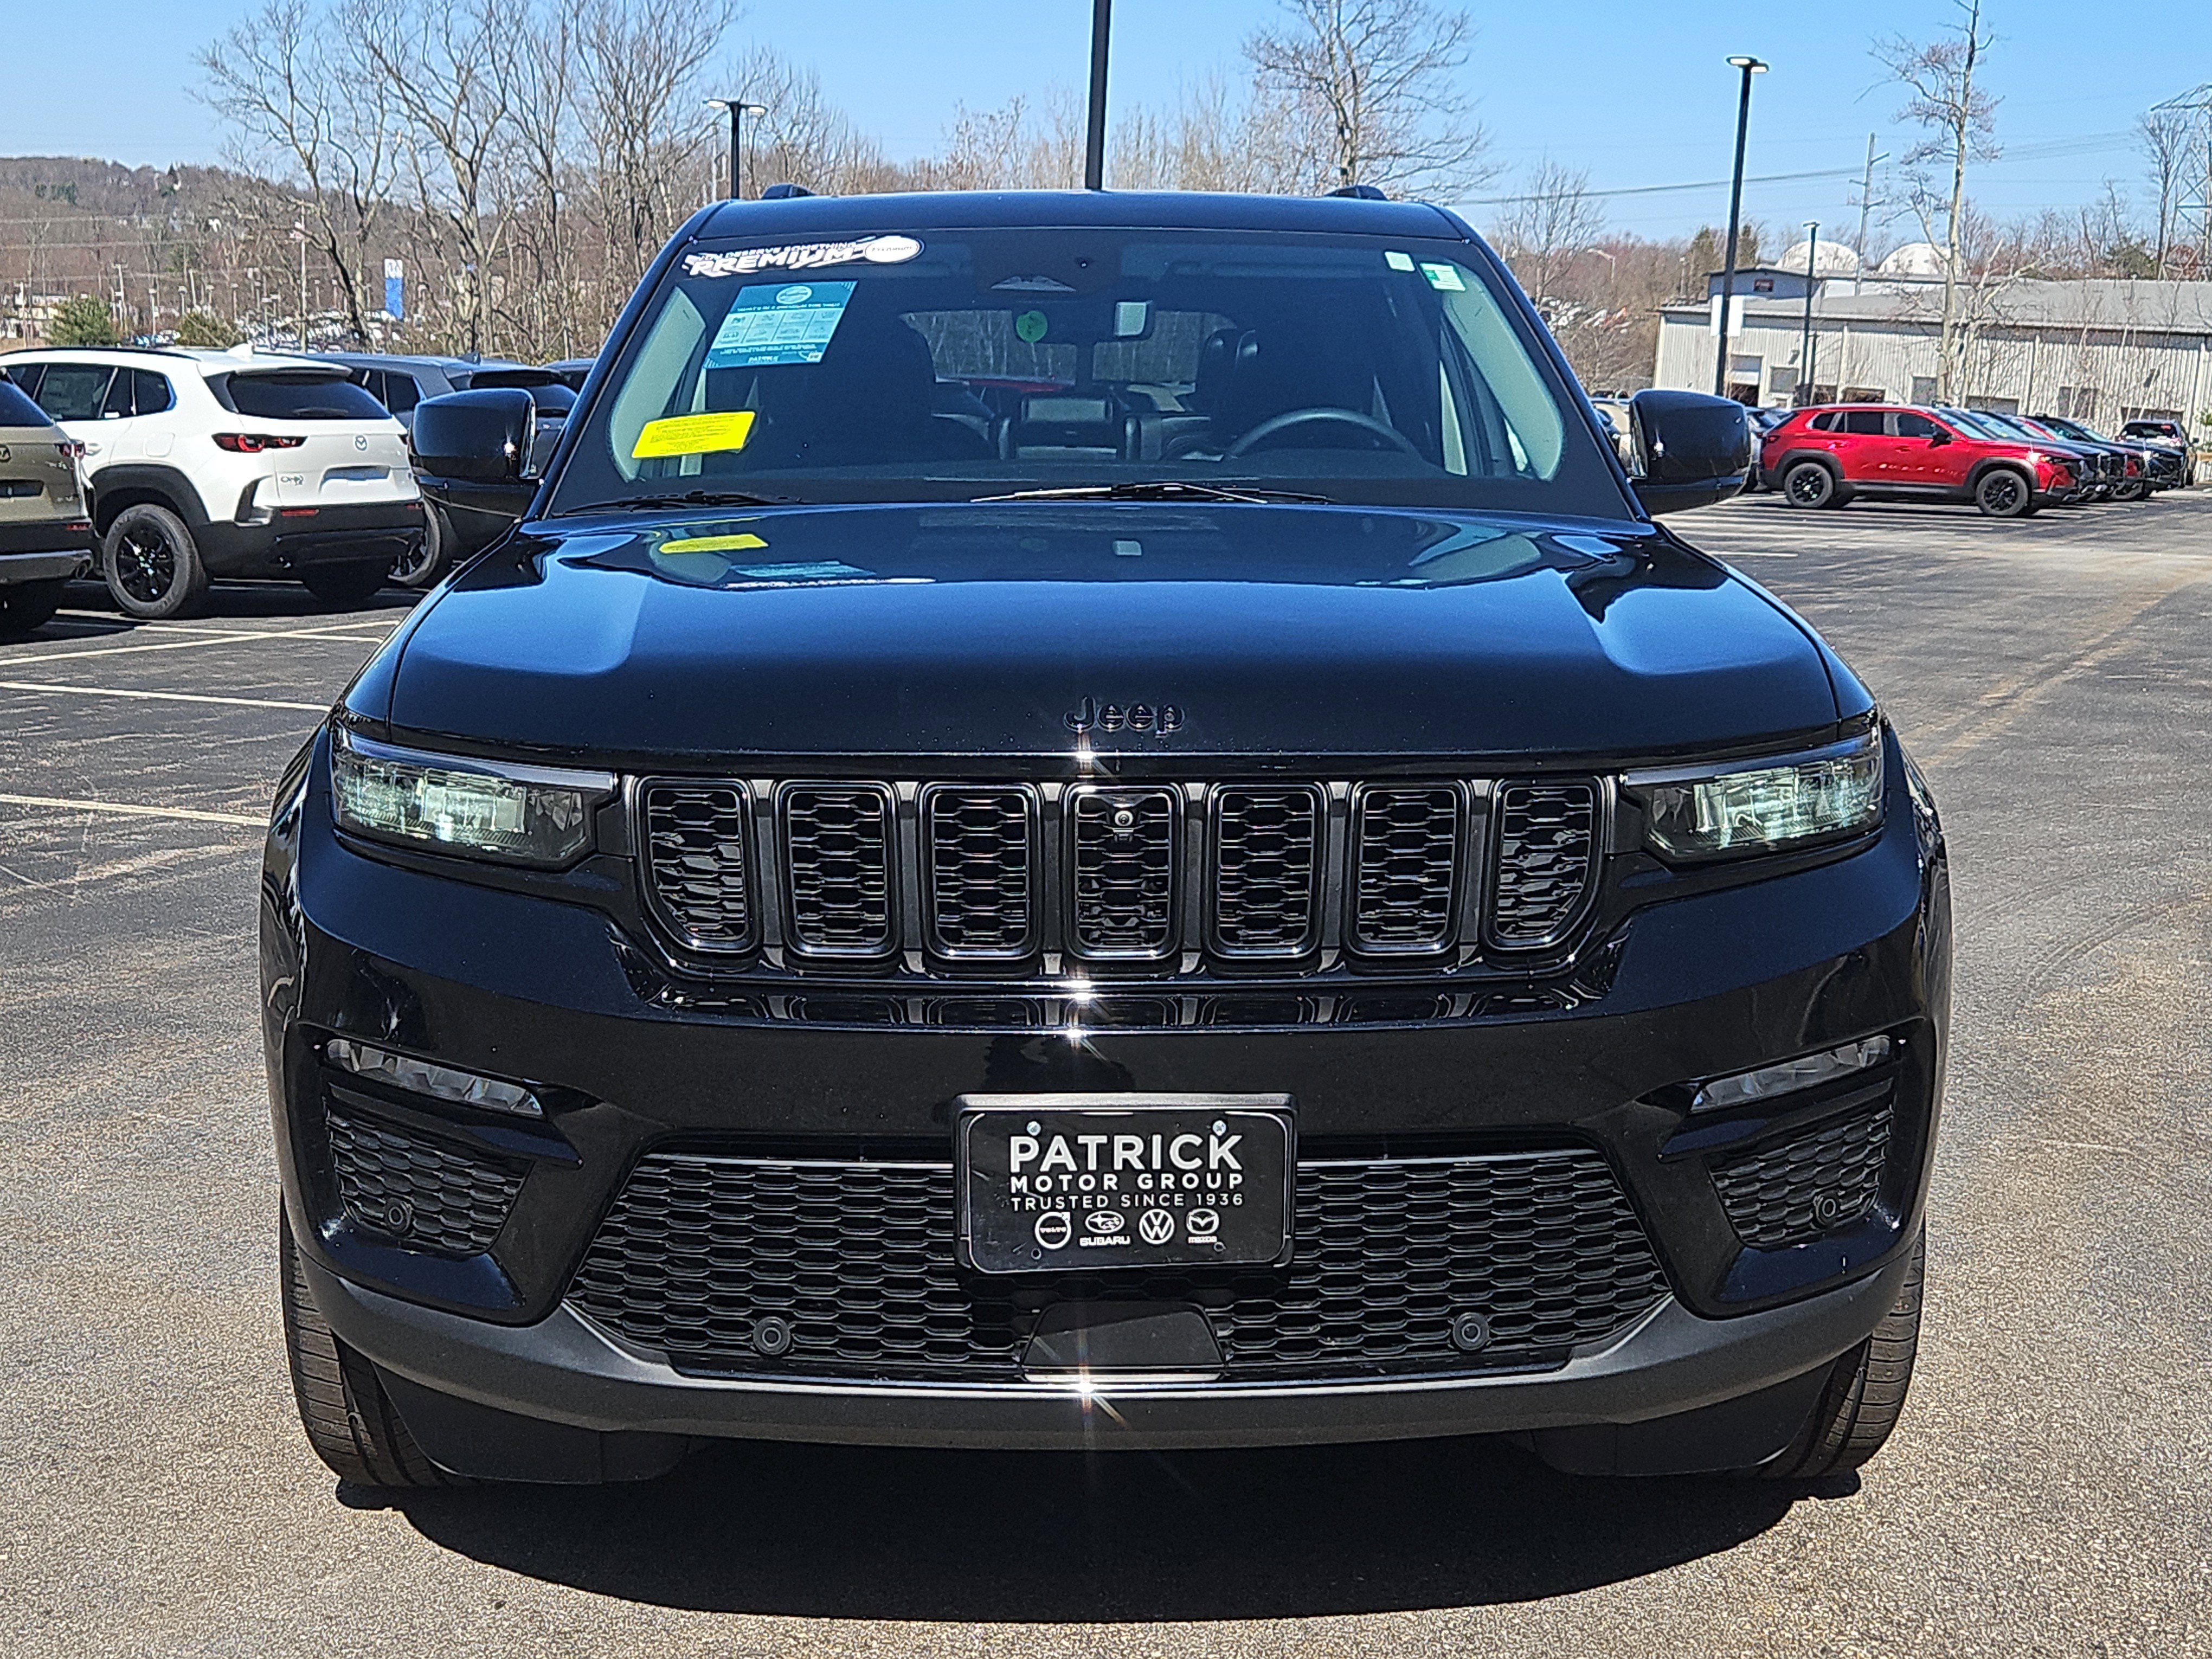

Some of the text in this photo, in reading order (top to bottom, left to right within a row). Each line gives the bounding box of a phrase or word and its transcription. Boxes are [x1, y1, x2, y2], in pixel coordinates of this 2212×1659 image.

[689, 246, 854, 276] PREMIUM
[1063, 697, 1185, 738] Jeep
[1010, 1134, 1243, 1173] PATRICK
[1011, 1173, 1243, 1194] MOTOR GROUP
[1011, 1193, 1243, 1212] TRUSTED SINCE 1936
[1079, 1235, 1130, 1247] SUBARU
